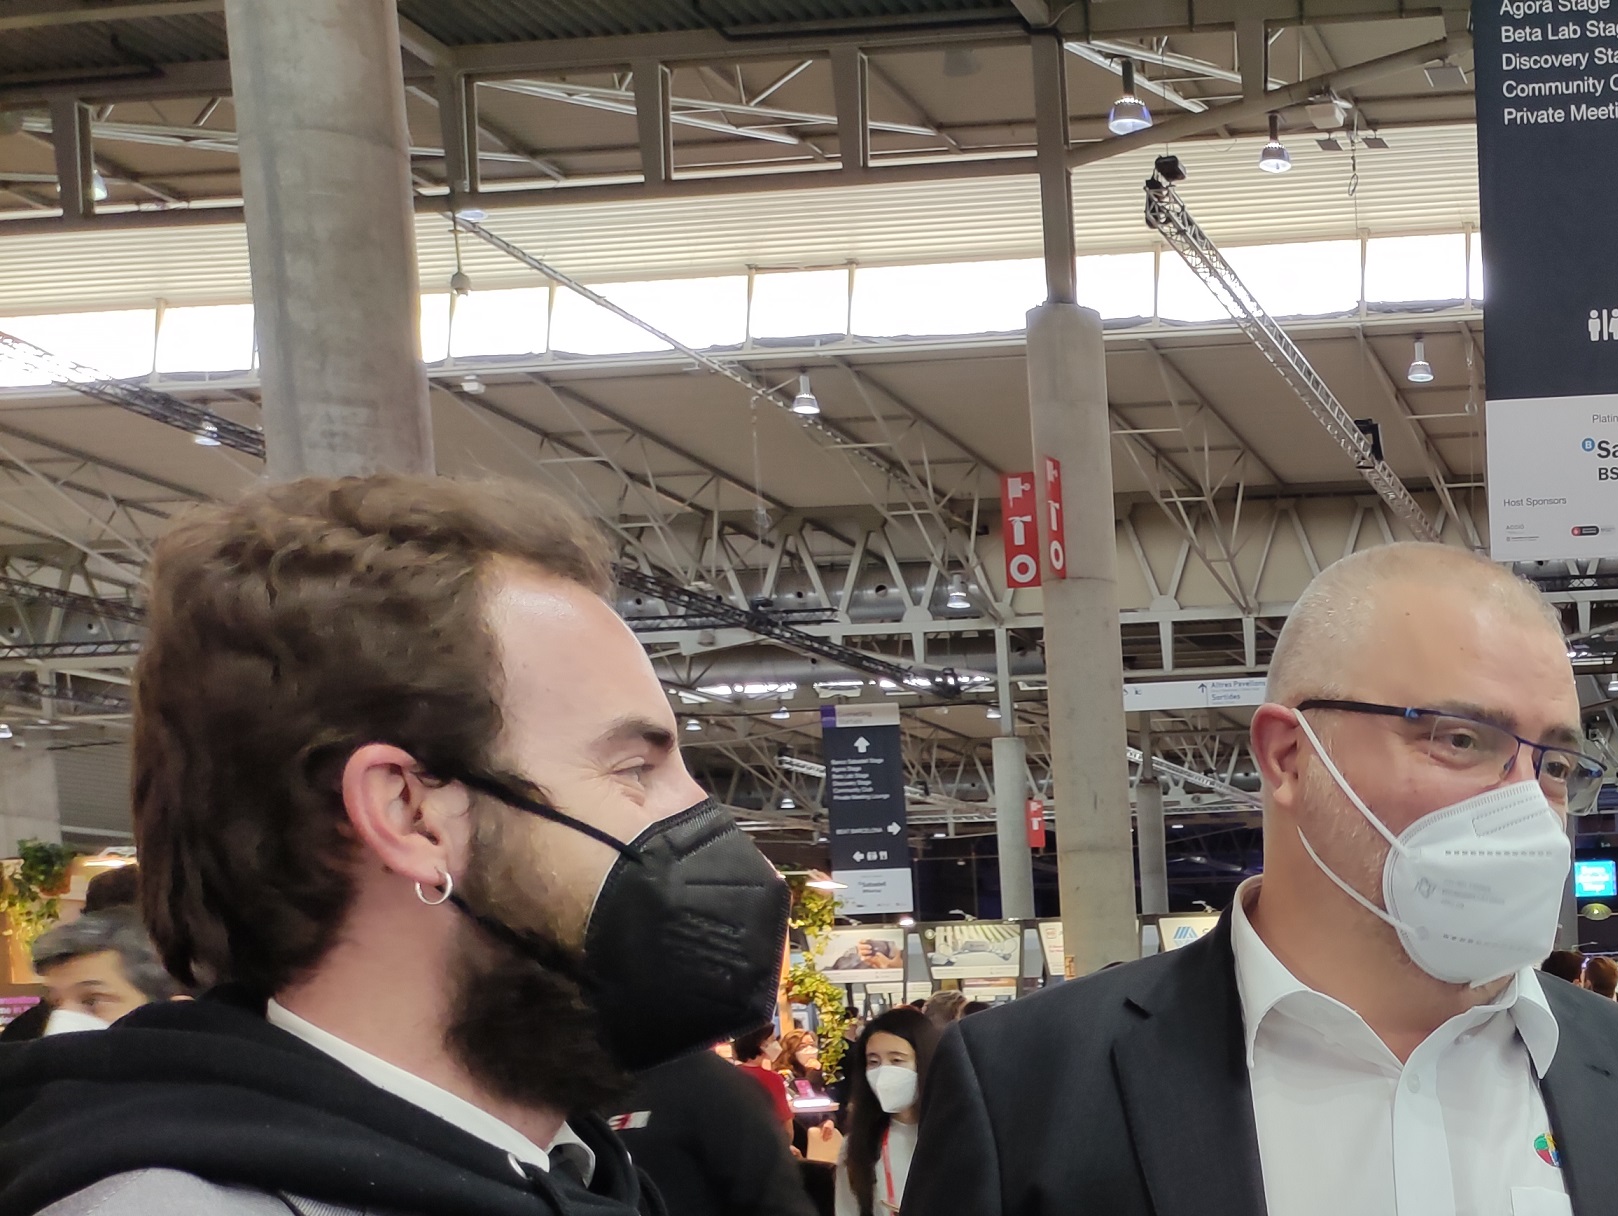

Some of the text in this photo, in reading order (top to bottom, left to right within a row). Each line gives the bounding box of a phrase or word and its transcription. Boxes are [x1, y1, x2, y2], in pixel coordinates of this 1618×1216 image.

[1499, 0, 1611, 19] Agora Stage
[1501, 25, 1542, 43] Beta
[1547, 22, 1581, 41] Lab
[1502, 50, 1589, 71] Discovery
[1502, 76, 1604, 98] Community
[1504, 105, 1565, 125] Private
[1503, 497, 1567, 508] Host Sponsors
